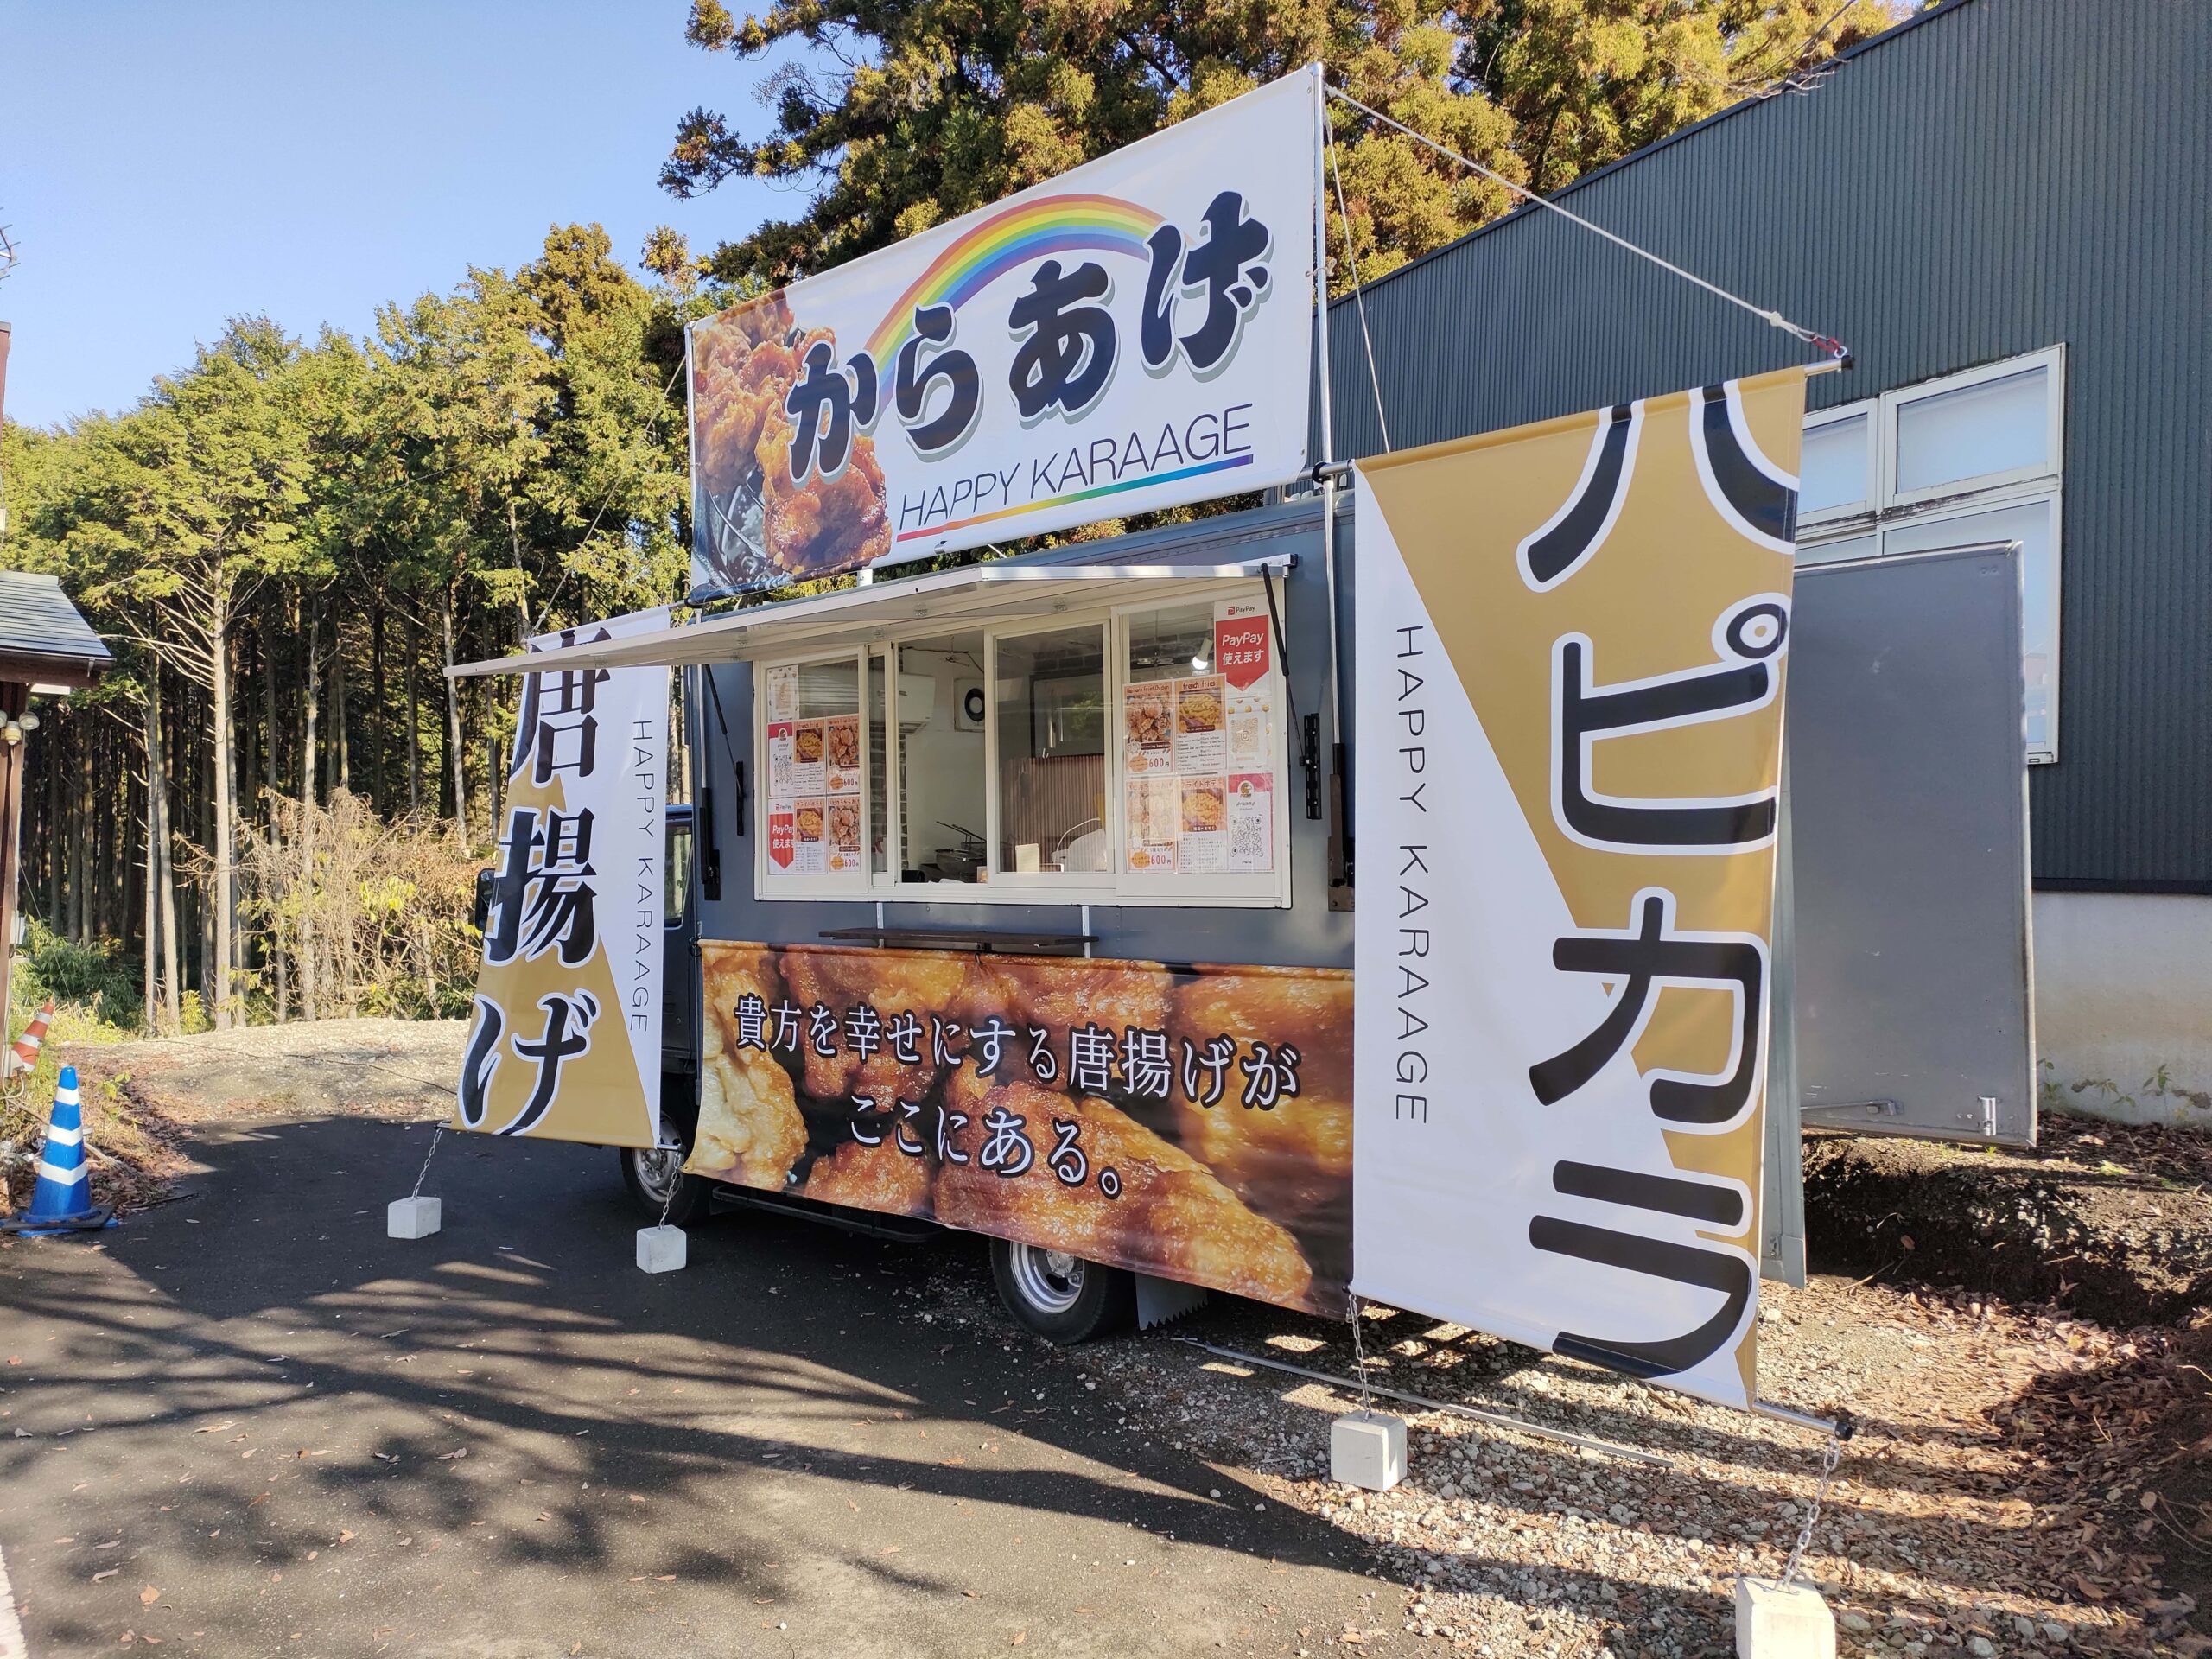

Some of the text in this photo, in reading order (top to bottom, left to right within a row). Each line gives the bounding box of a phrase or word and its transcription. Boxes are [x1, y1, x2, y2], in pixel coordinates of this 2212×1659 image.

[785, 189, 1273, 484] からあげ
[900, 404, 1254, 530] HAPPY KARAAGE
[1222, 632, 1264, 646] PayPay
[1222, 649, 1264, 666] 使えます
[461, 627, 611, 1136] 唐揚げ
[630, 719, 654, 1033] HAPPY KARAAGE
[1395, 624, 1428, 1125] HAPPY KARAAGE
[1528, 381, 1796, 1378] ハピカラ
[732, 993, 1300, 1109] 貴方を幸せにする唐揚げが
[849, 1093, 1123, 1200] ここにある。
